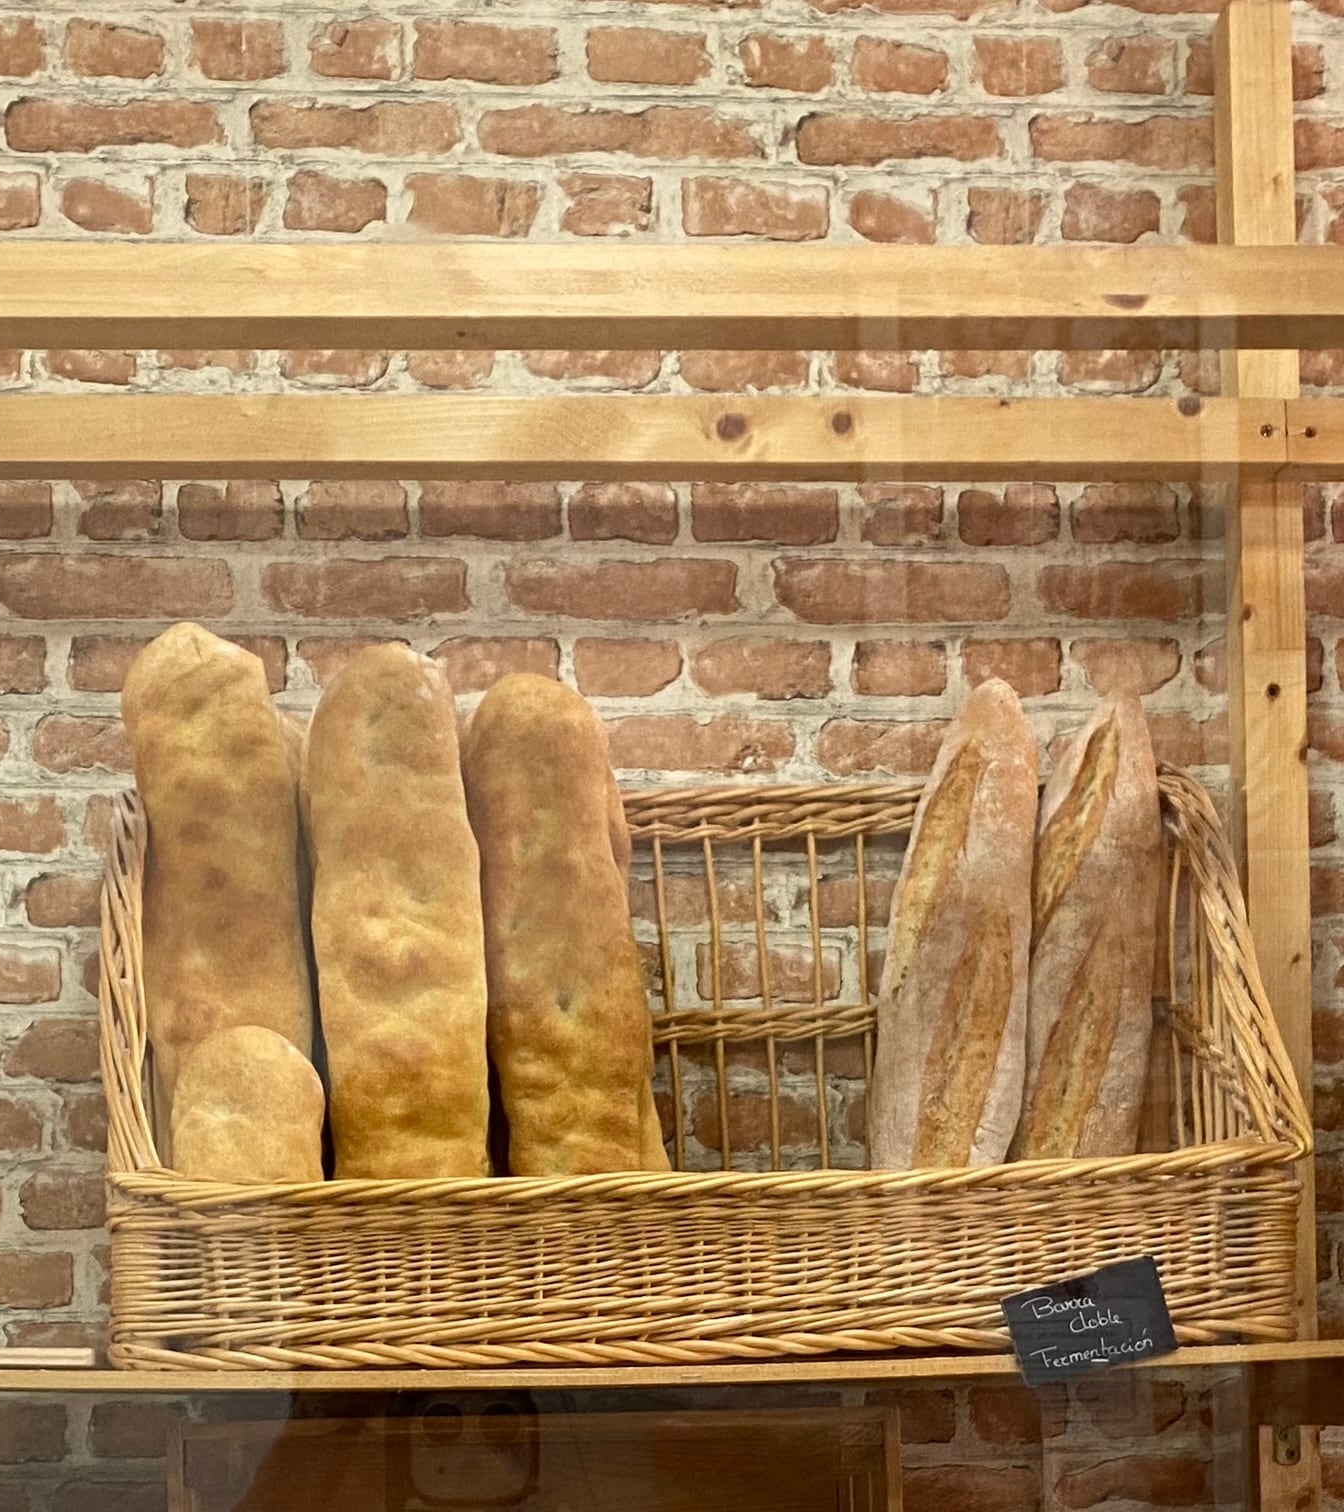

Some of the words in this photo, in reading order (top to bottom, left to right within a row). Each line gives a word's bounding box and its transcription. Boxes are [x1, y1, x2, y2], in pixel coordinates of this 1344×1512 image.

[1021, 1295, 1096, 1319] Barra
[1069, 1309, 1123, 1334] doble
[1030, 1328, 1154, 1369] Fermentación
